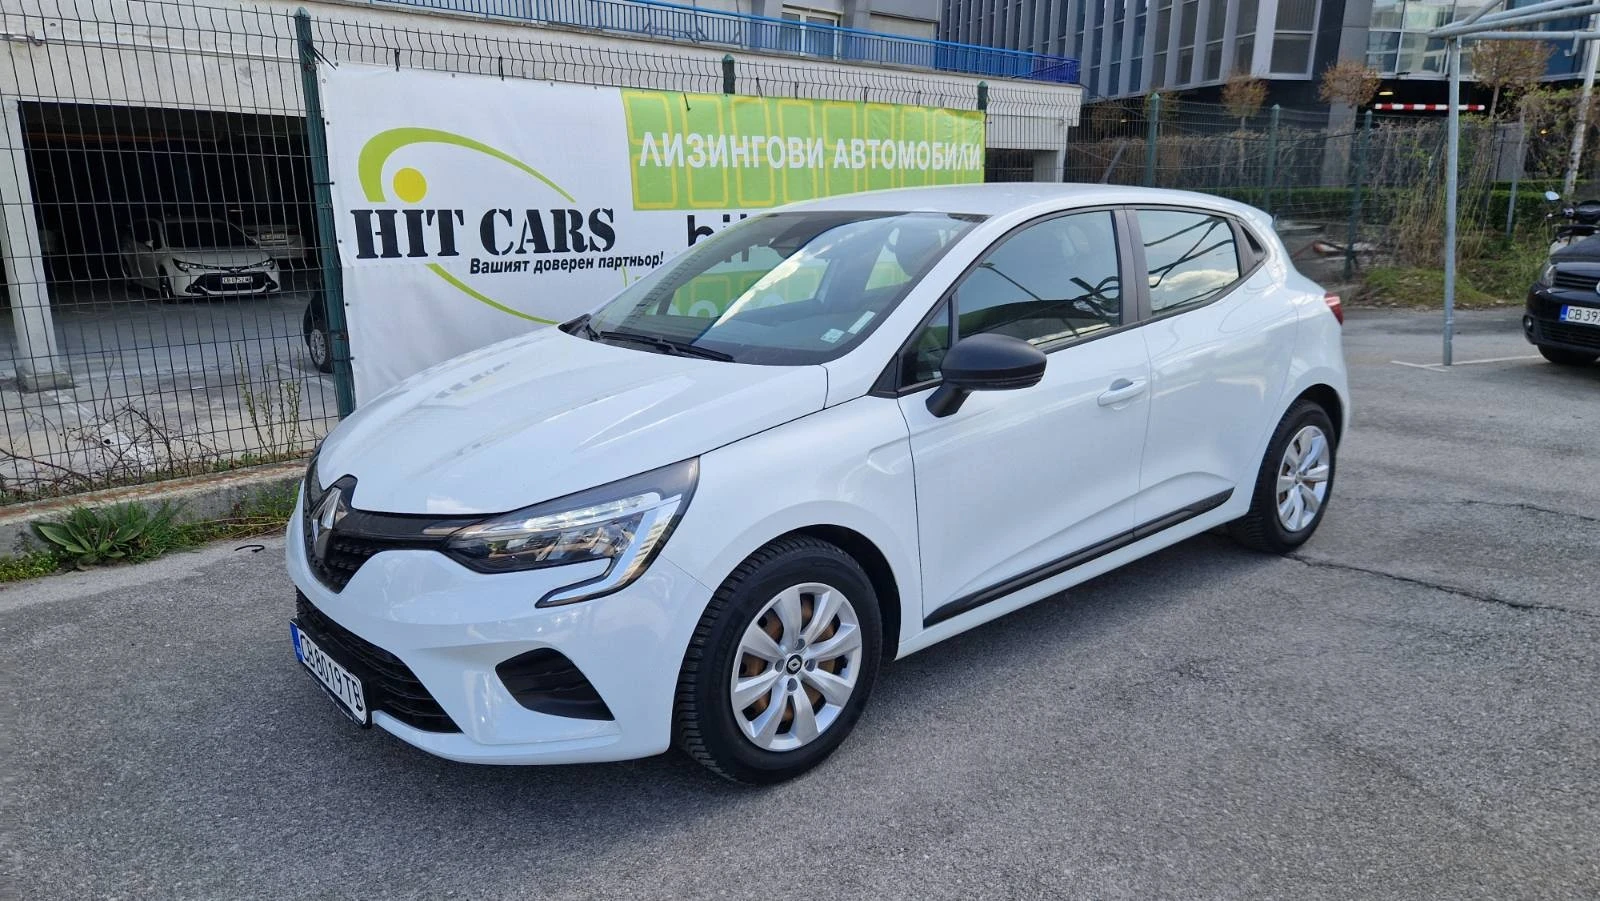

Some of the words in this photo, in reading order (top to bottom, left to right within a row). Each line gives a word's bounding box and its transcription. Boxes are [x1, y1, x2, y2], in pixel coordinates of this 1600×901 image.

[640, 132, 824, 169] ЛИЗИНГОВИ
[833, 138, 981, 171] АВТОМОБИЛИ
[350, 208, 465, 260] HIT
[479, 207, 616, 256] CARS
[469, 257, 531, 275] Вашият
[533, 257, 594, 273] доверен
[598, 251, 665, 270] партньор!
